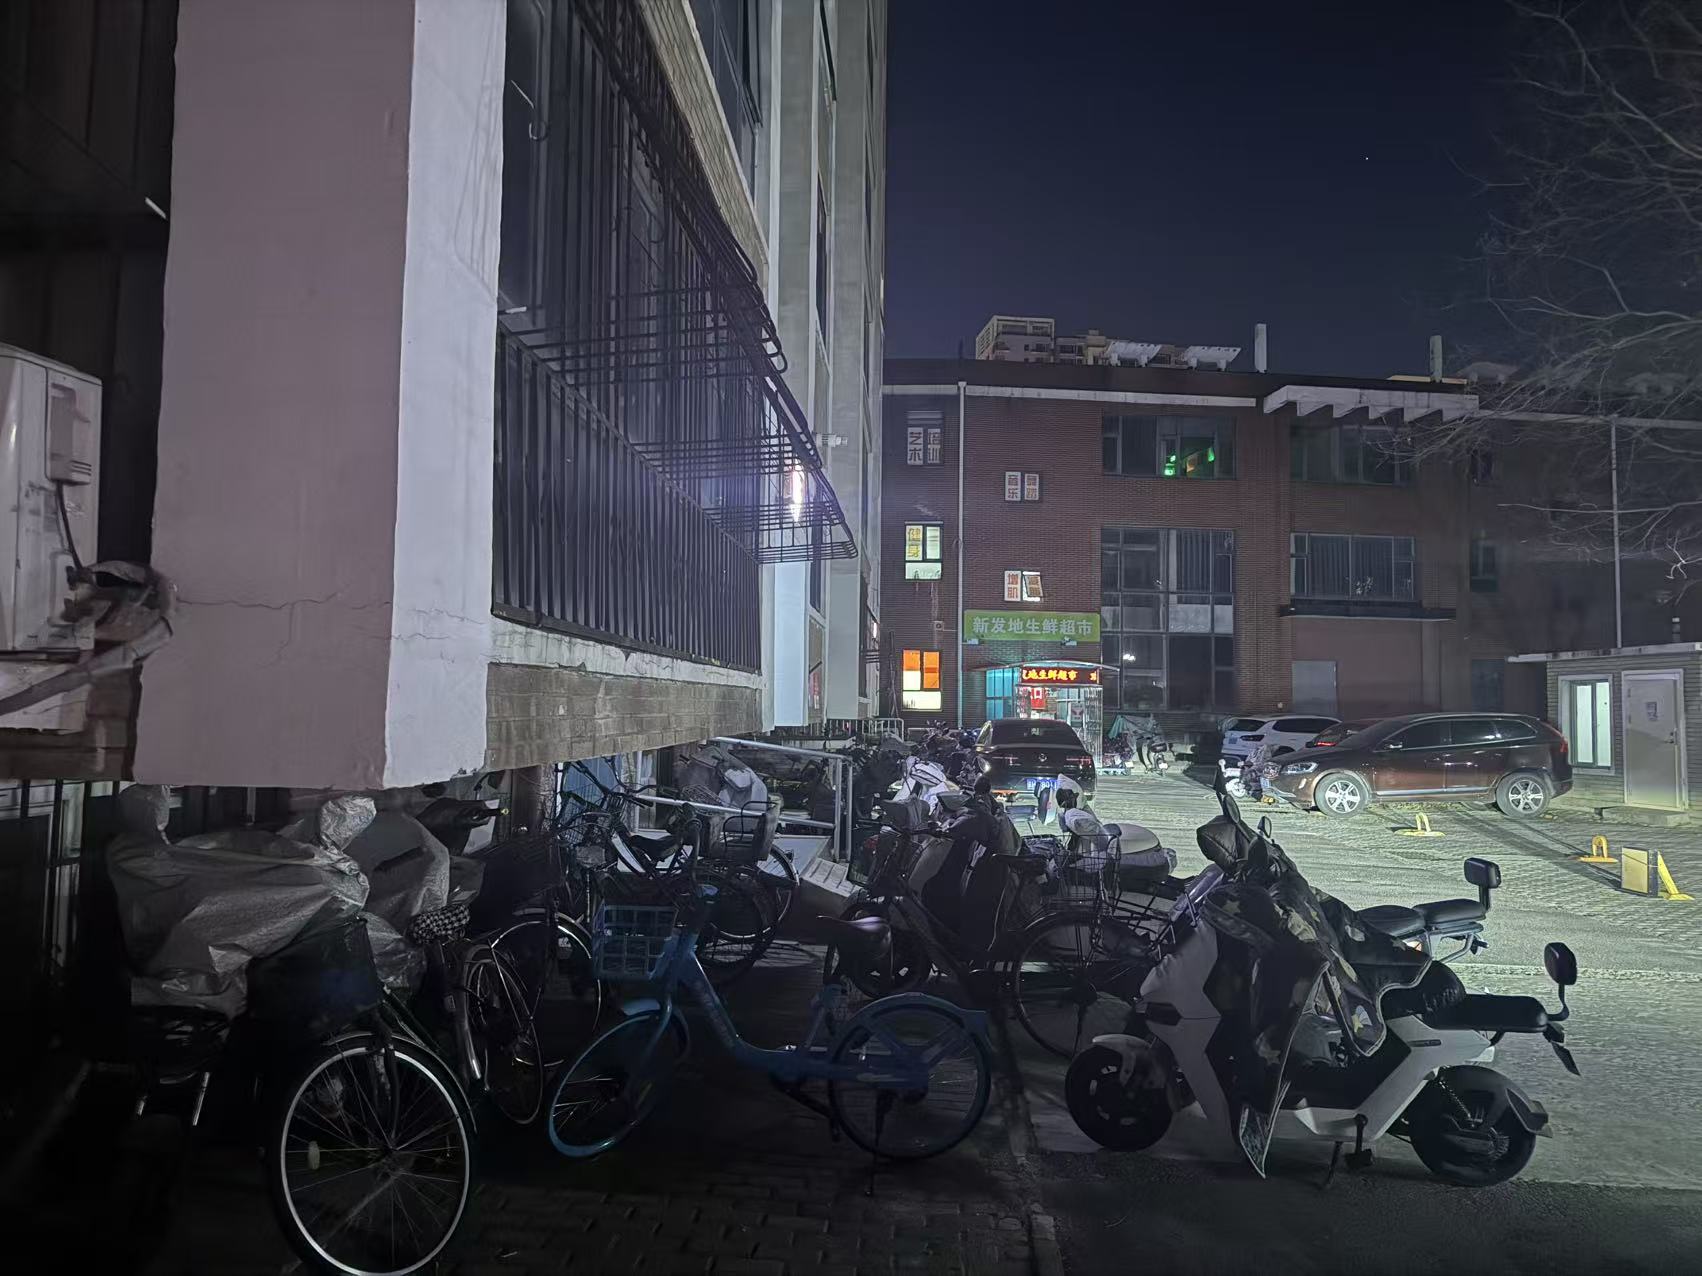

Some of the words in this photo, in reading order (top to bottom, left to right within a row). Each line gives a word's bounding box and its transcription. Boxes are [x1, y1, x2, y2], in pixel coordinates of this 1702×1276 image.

[909, 431, 922, 462] 艺术
[908, 527, 921, 558] 健身
[972, 616, 1093, 636] 新发地生鲜超市
